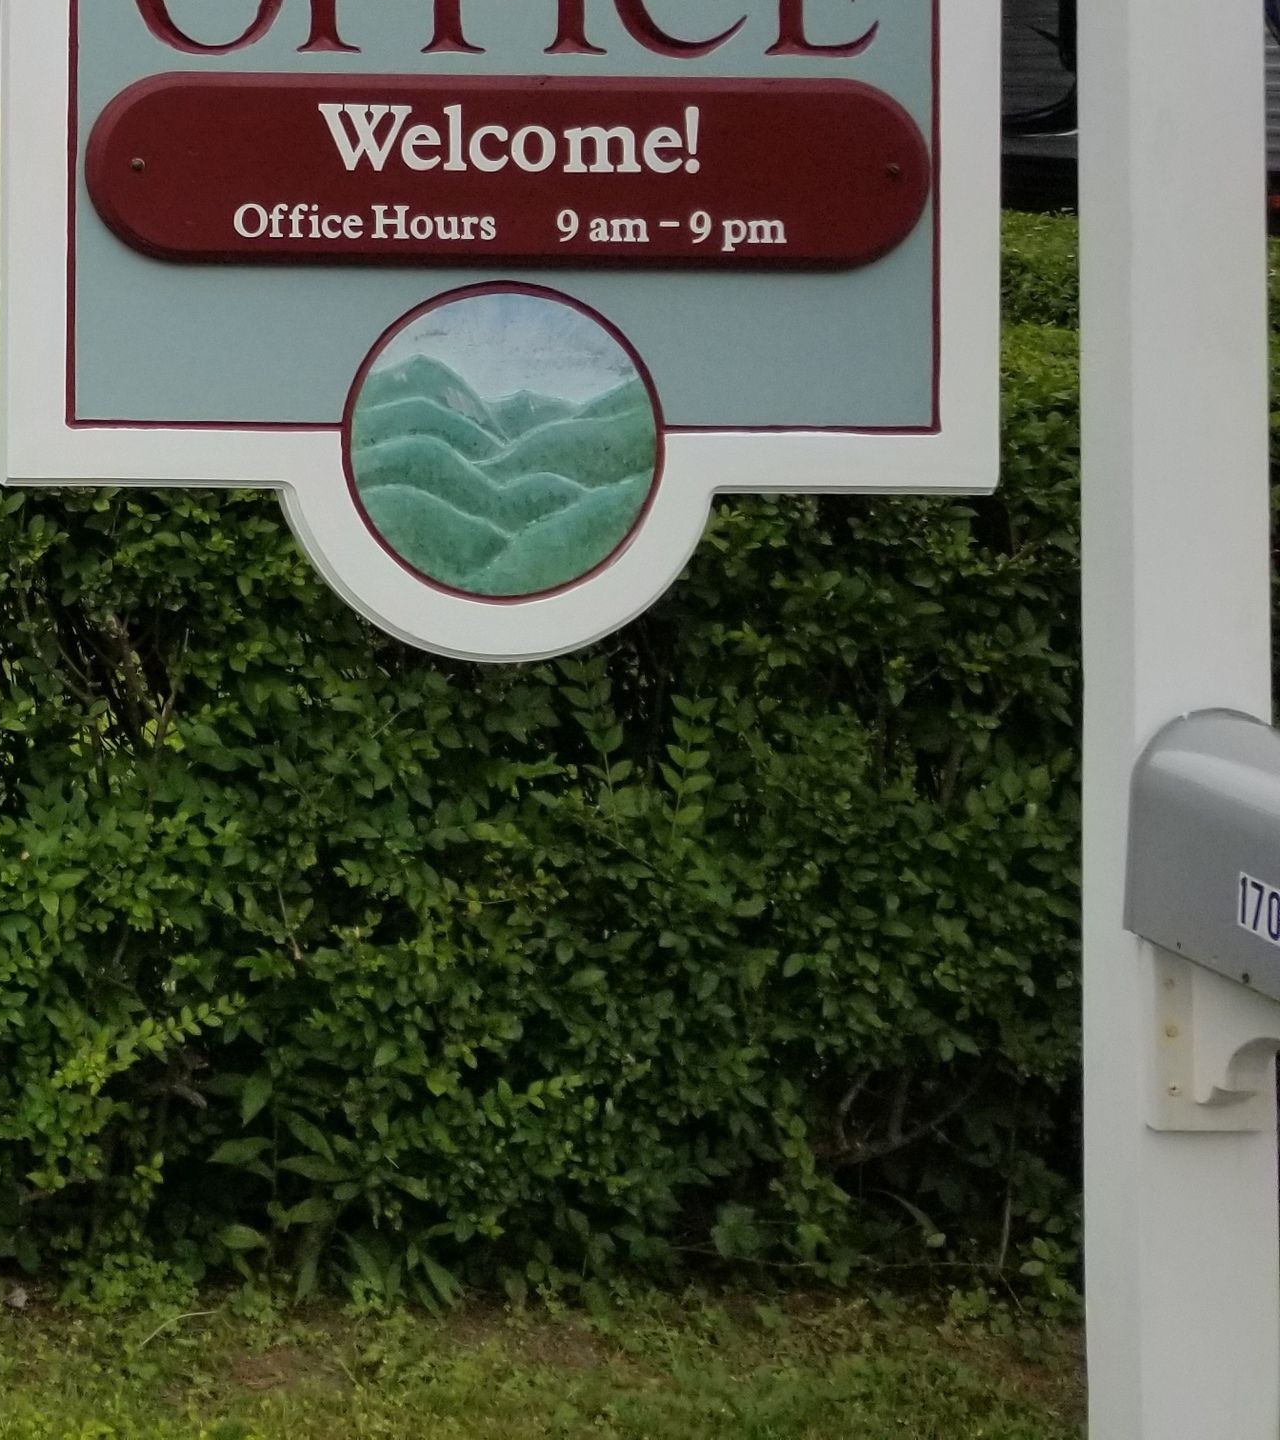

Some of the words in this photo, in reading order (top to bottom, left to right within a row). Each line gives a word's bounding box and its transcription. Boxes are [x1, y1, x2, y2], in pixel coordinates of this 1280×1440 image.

[317, 102, 701, 174] Welcome!
[233, 203, 364, 239] Office
[371, 205, 497, 241] Hours
[556, 209, 579, 242] 9
[589, 217, 650, 243] am
[689, 210, 712, 244] 9
[721, 219, 787, 252] pm
[1241, 877, 1280, 941] 170
